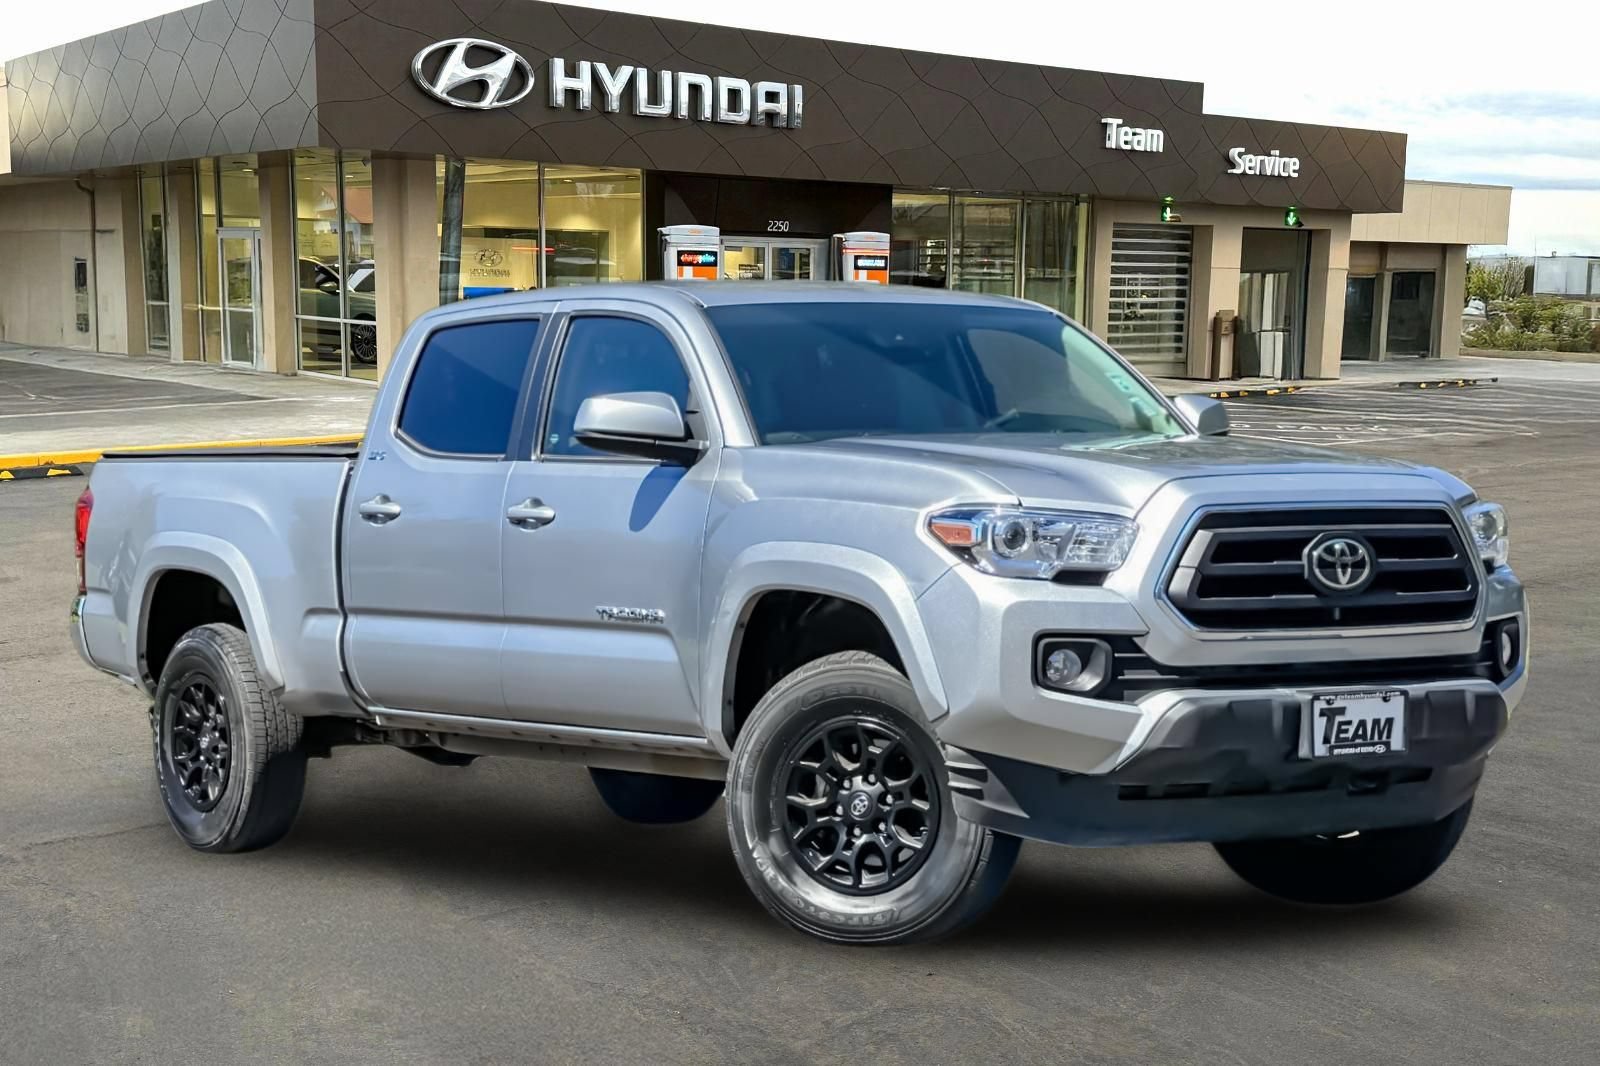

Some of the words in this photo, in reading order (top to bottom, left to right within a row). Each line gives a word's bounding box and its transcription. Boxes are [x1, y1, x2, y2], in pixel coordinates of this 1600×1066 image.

[549, 57, 802, 129] HYUNDAI
[1101, 118, 1164, 152] Team
[1227, 147, 1300, 177] Service
[767, 220, 790, 232] 2250
[1318, 706, 1394, 744] TEAM
